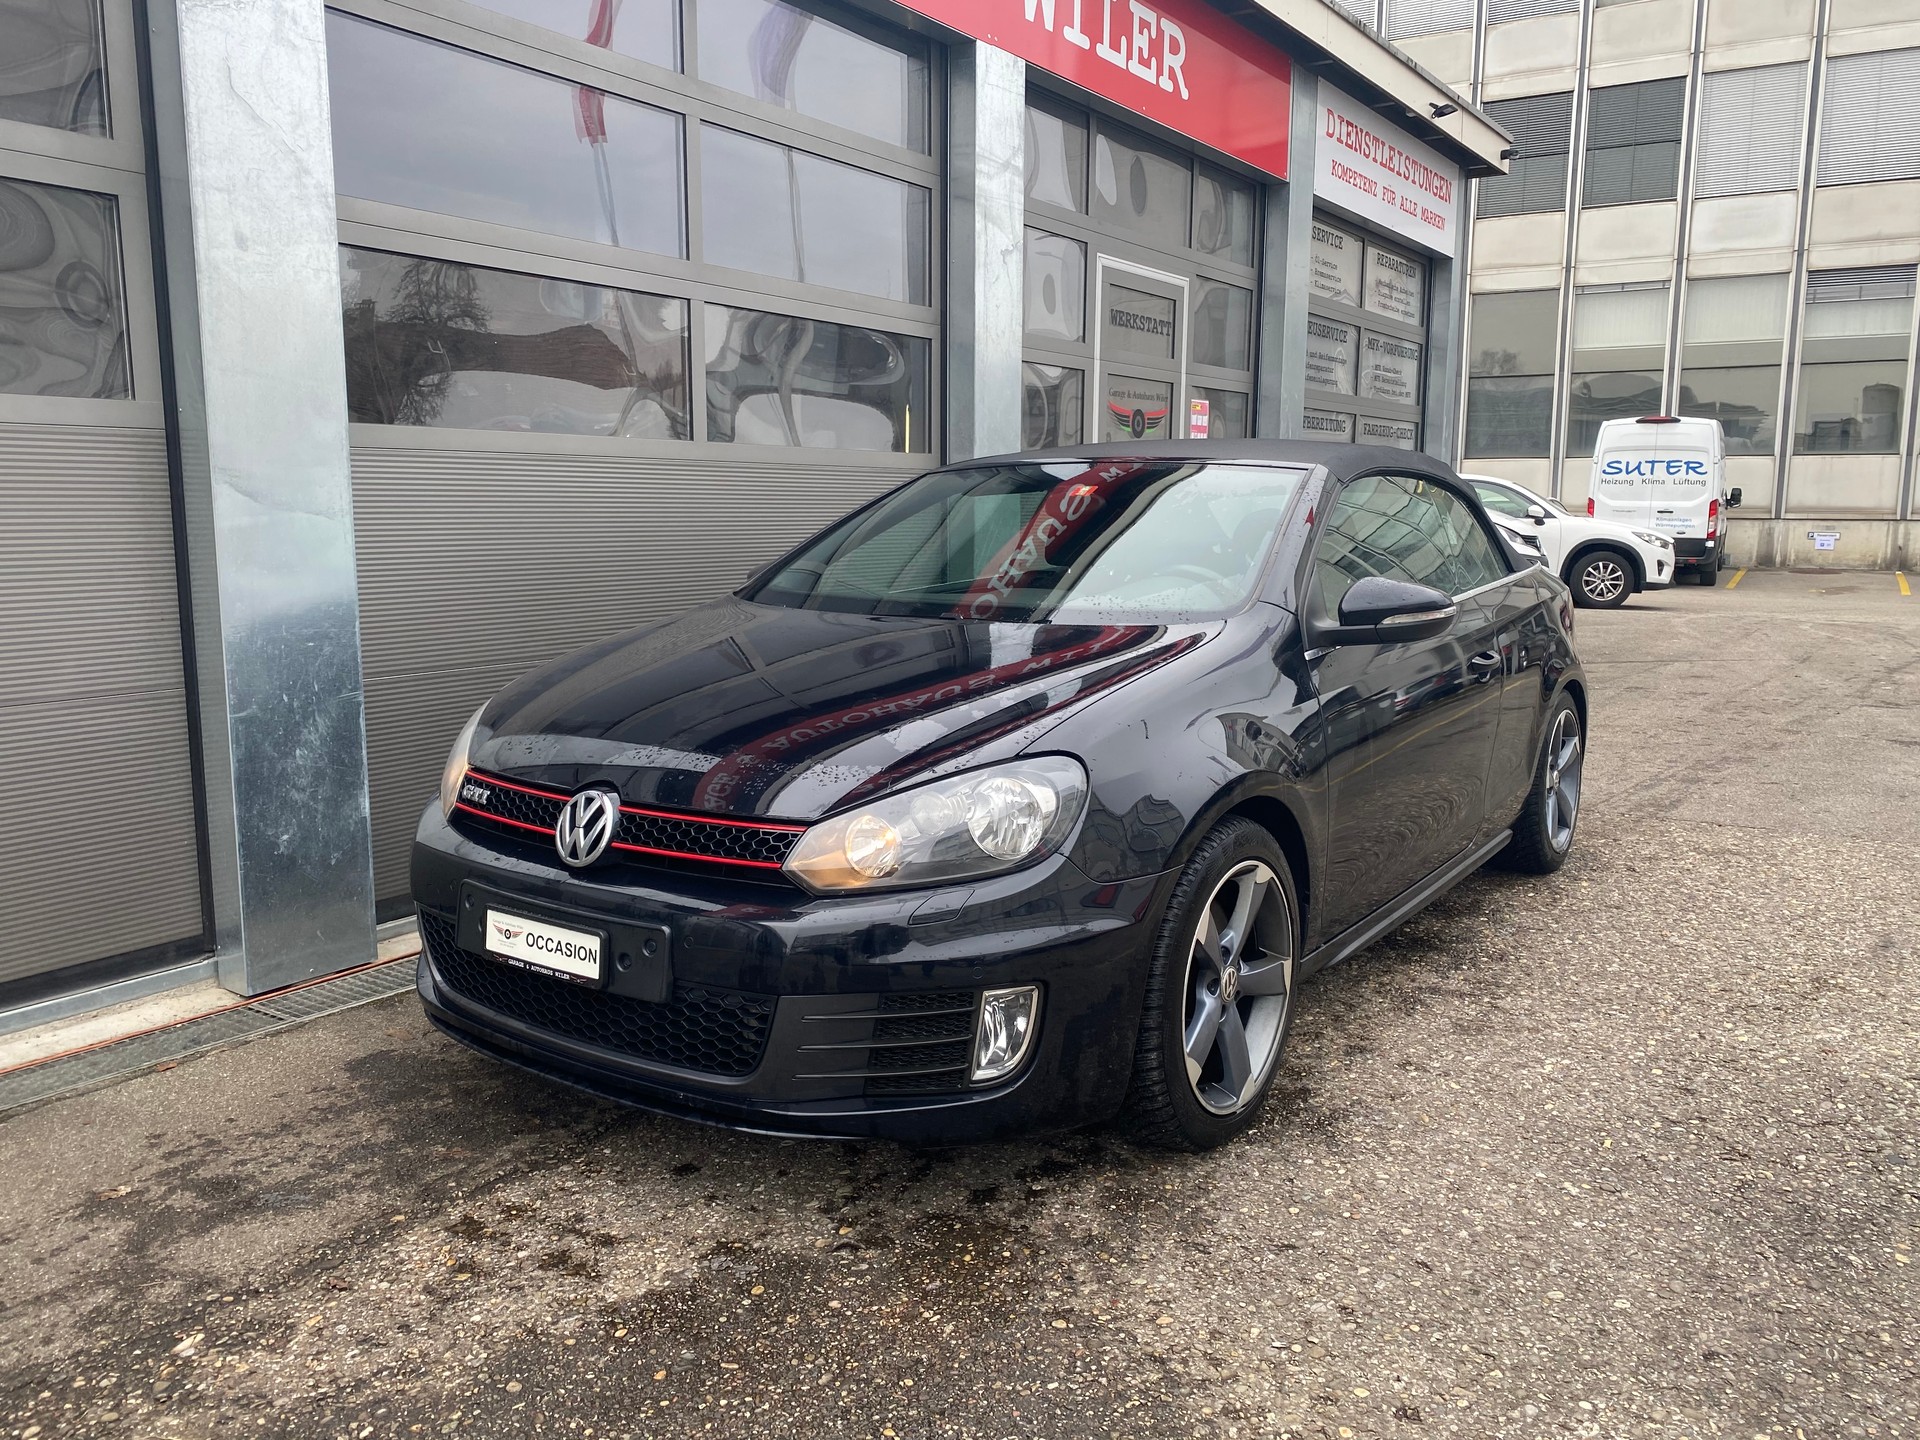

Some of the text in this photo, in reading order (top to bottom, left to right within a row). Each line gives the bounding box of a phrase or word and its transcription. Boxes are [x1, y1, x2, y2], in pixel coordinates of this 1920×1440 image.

[1326, 108, 1452, 204] DIENSTLEISTUNGEN
[1331, 159, 1446, 231] KOMPETENZ FÜR ALLE MARKEN
[1312, 225, 1344, 250] SERVICE
[1377, 252, 1417, 279] REPARATUREN
[1110, 308, 1172, 336] WERKSTATT
[1363, 423, 1414, 440] FAHRZEUG-CHECK
[1602, 460, 1707, 476] SUTER
[1601, 478, 1634, 486] Heizung
[1673, 478, 1706, 487] Lüftung
[462, 784, 491, 805] GTI
[526, 932, 598, 965] OCCASION
[555, 971, 570, 980] WILER
